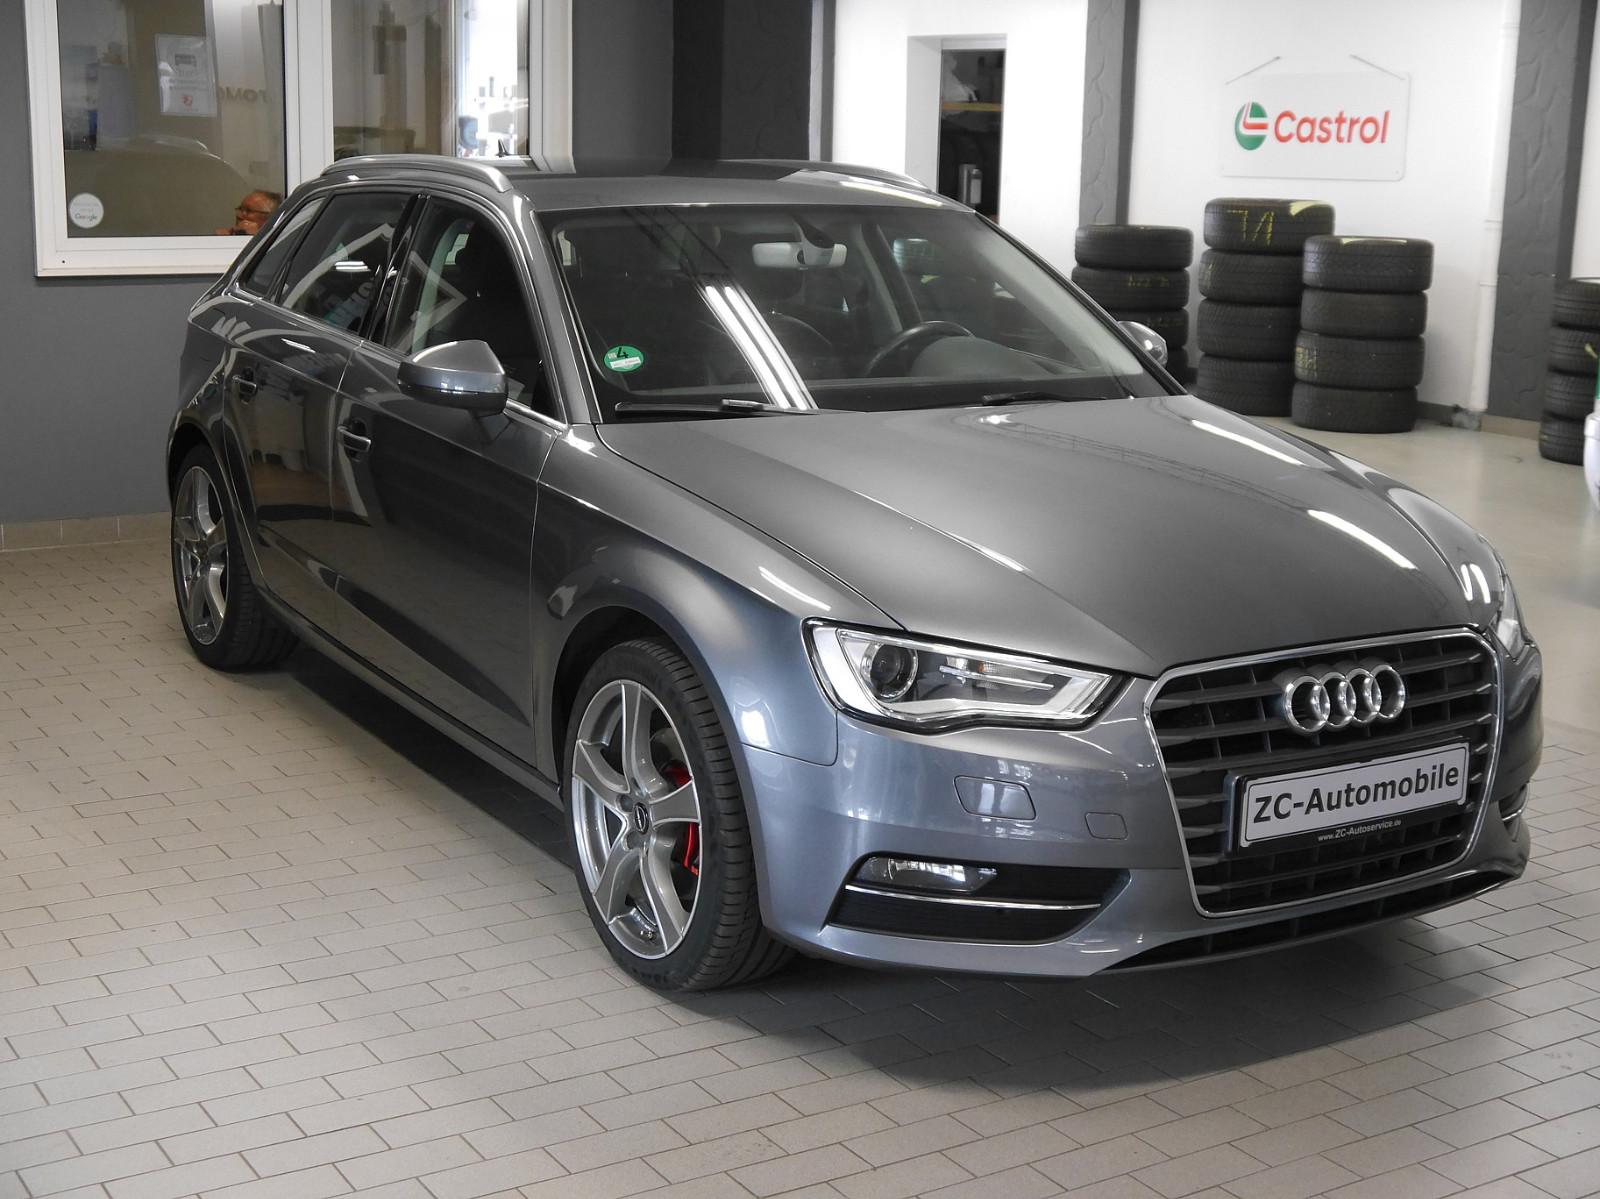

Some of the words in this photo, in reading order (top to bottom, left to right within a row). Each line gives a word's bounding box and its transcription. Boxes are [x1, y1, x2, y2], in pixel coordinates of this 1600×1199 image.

[1274, 110, 1390, 144] Castrol
[616, 347, 629, 358] 4
[1253, 764, 1459, 823] ZC-Automobile
[1318, 819, 1402, 841] www.ZC-Autoservice.de
